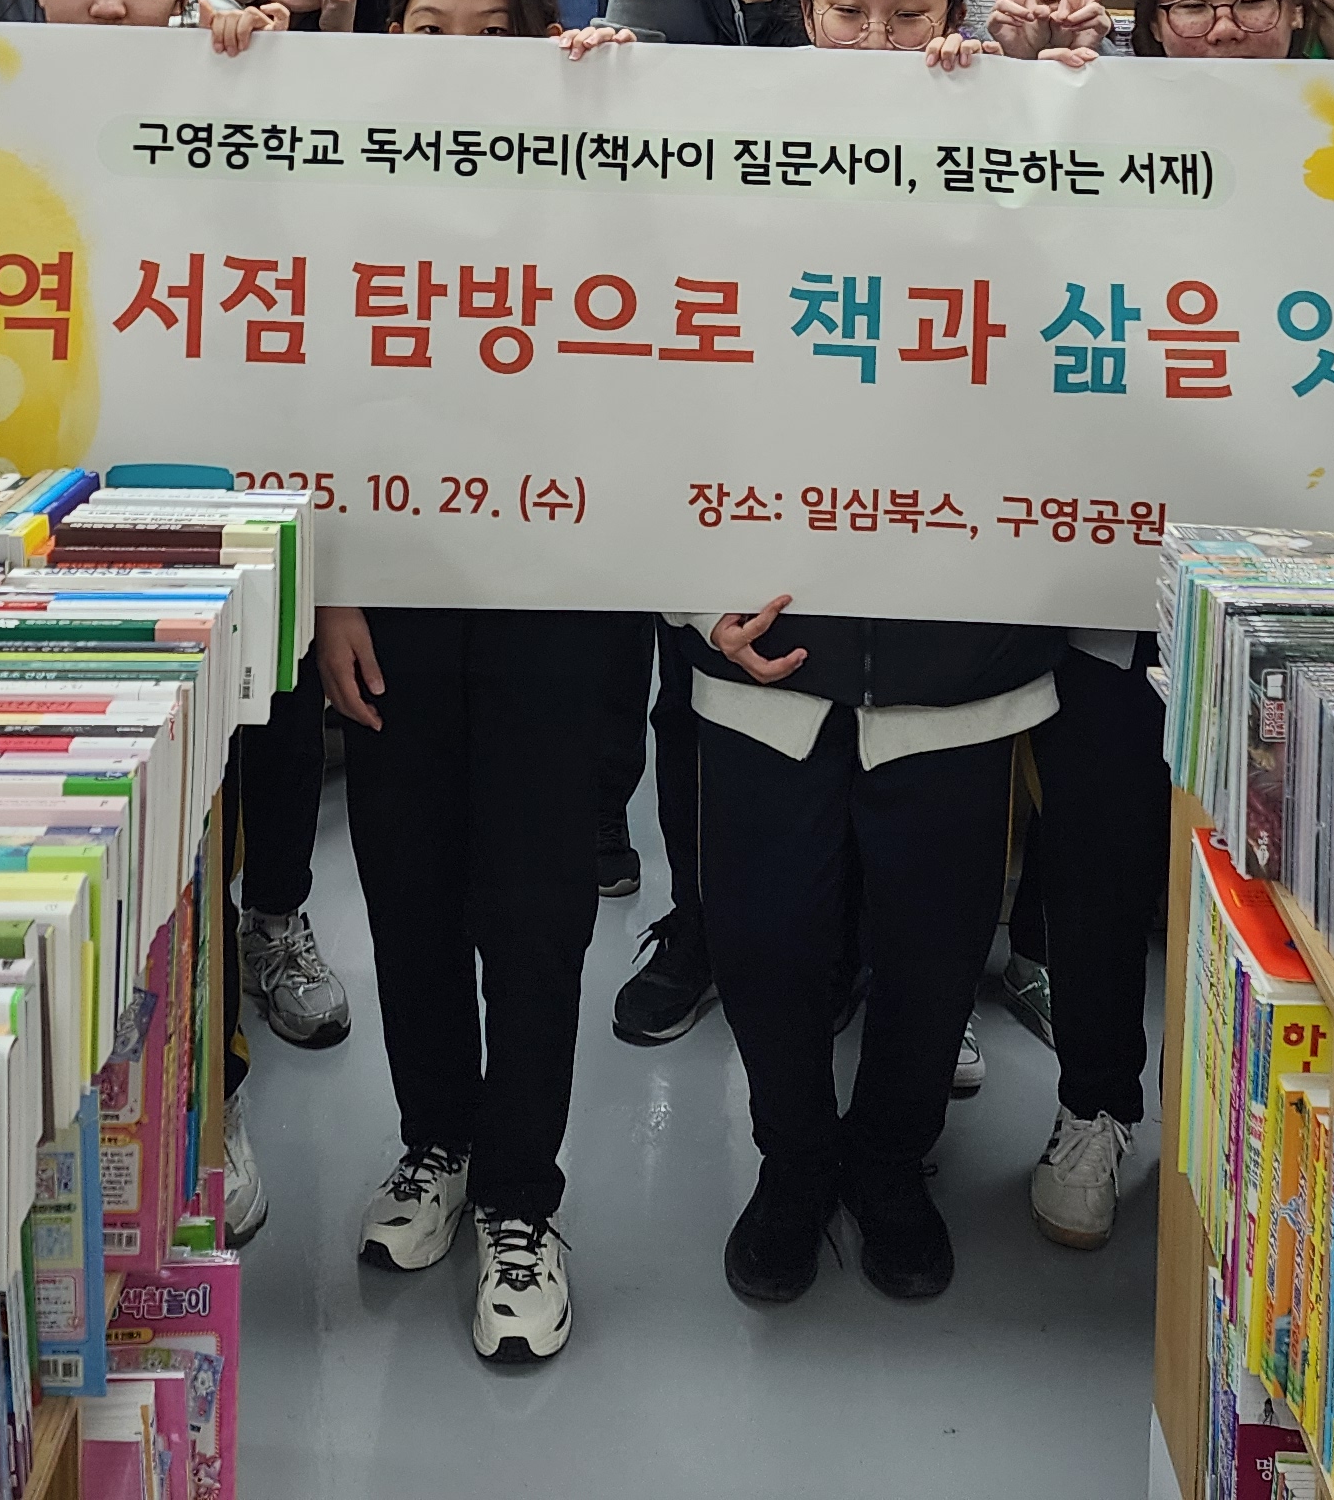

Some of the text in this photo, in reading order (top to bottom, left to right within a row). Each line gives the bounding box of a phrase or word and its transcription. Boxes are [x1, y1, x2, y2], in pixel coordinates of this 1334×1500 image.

[132, 122, 1214, 200] 구영중학교 독서동아리(책사이 질문사이, 질문하는 서재)
[112, 252, 308, 368] 서점
[352, 259, 755, 374] 탐방으로
[789, 271, 1007, 386] 책과
[1039, 279, 1241, 399] 삶을
[367, 474, 421, 516] 10.
[438, 476, 501, 519] 29.
[519, 474, 586, 525] (수)
[688, 483, 782, 528] 장소:
[801, 486, 979, 541] 일심북스,
[997, 496, 1166, 547] 구영공원
[120, 1283, 210, 1319] 색칠놀이
